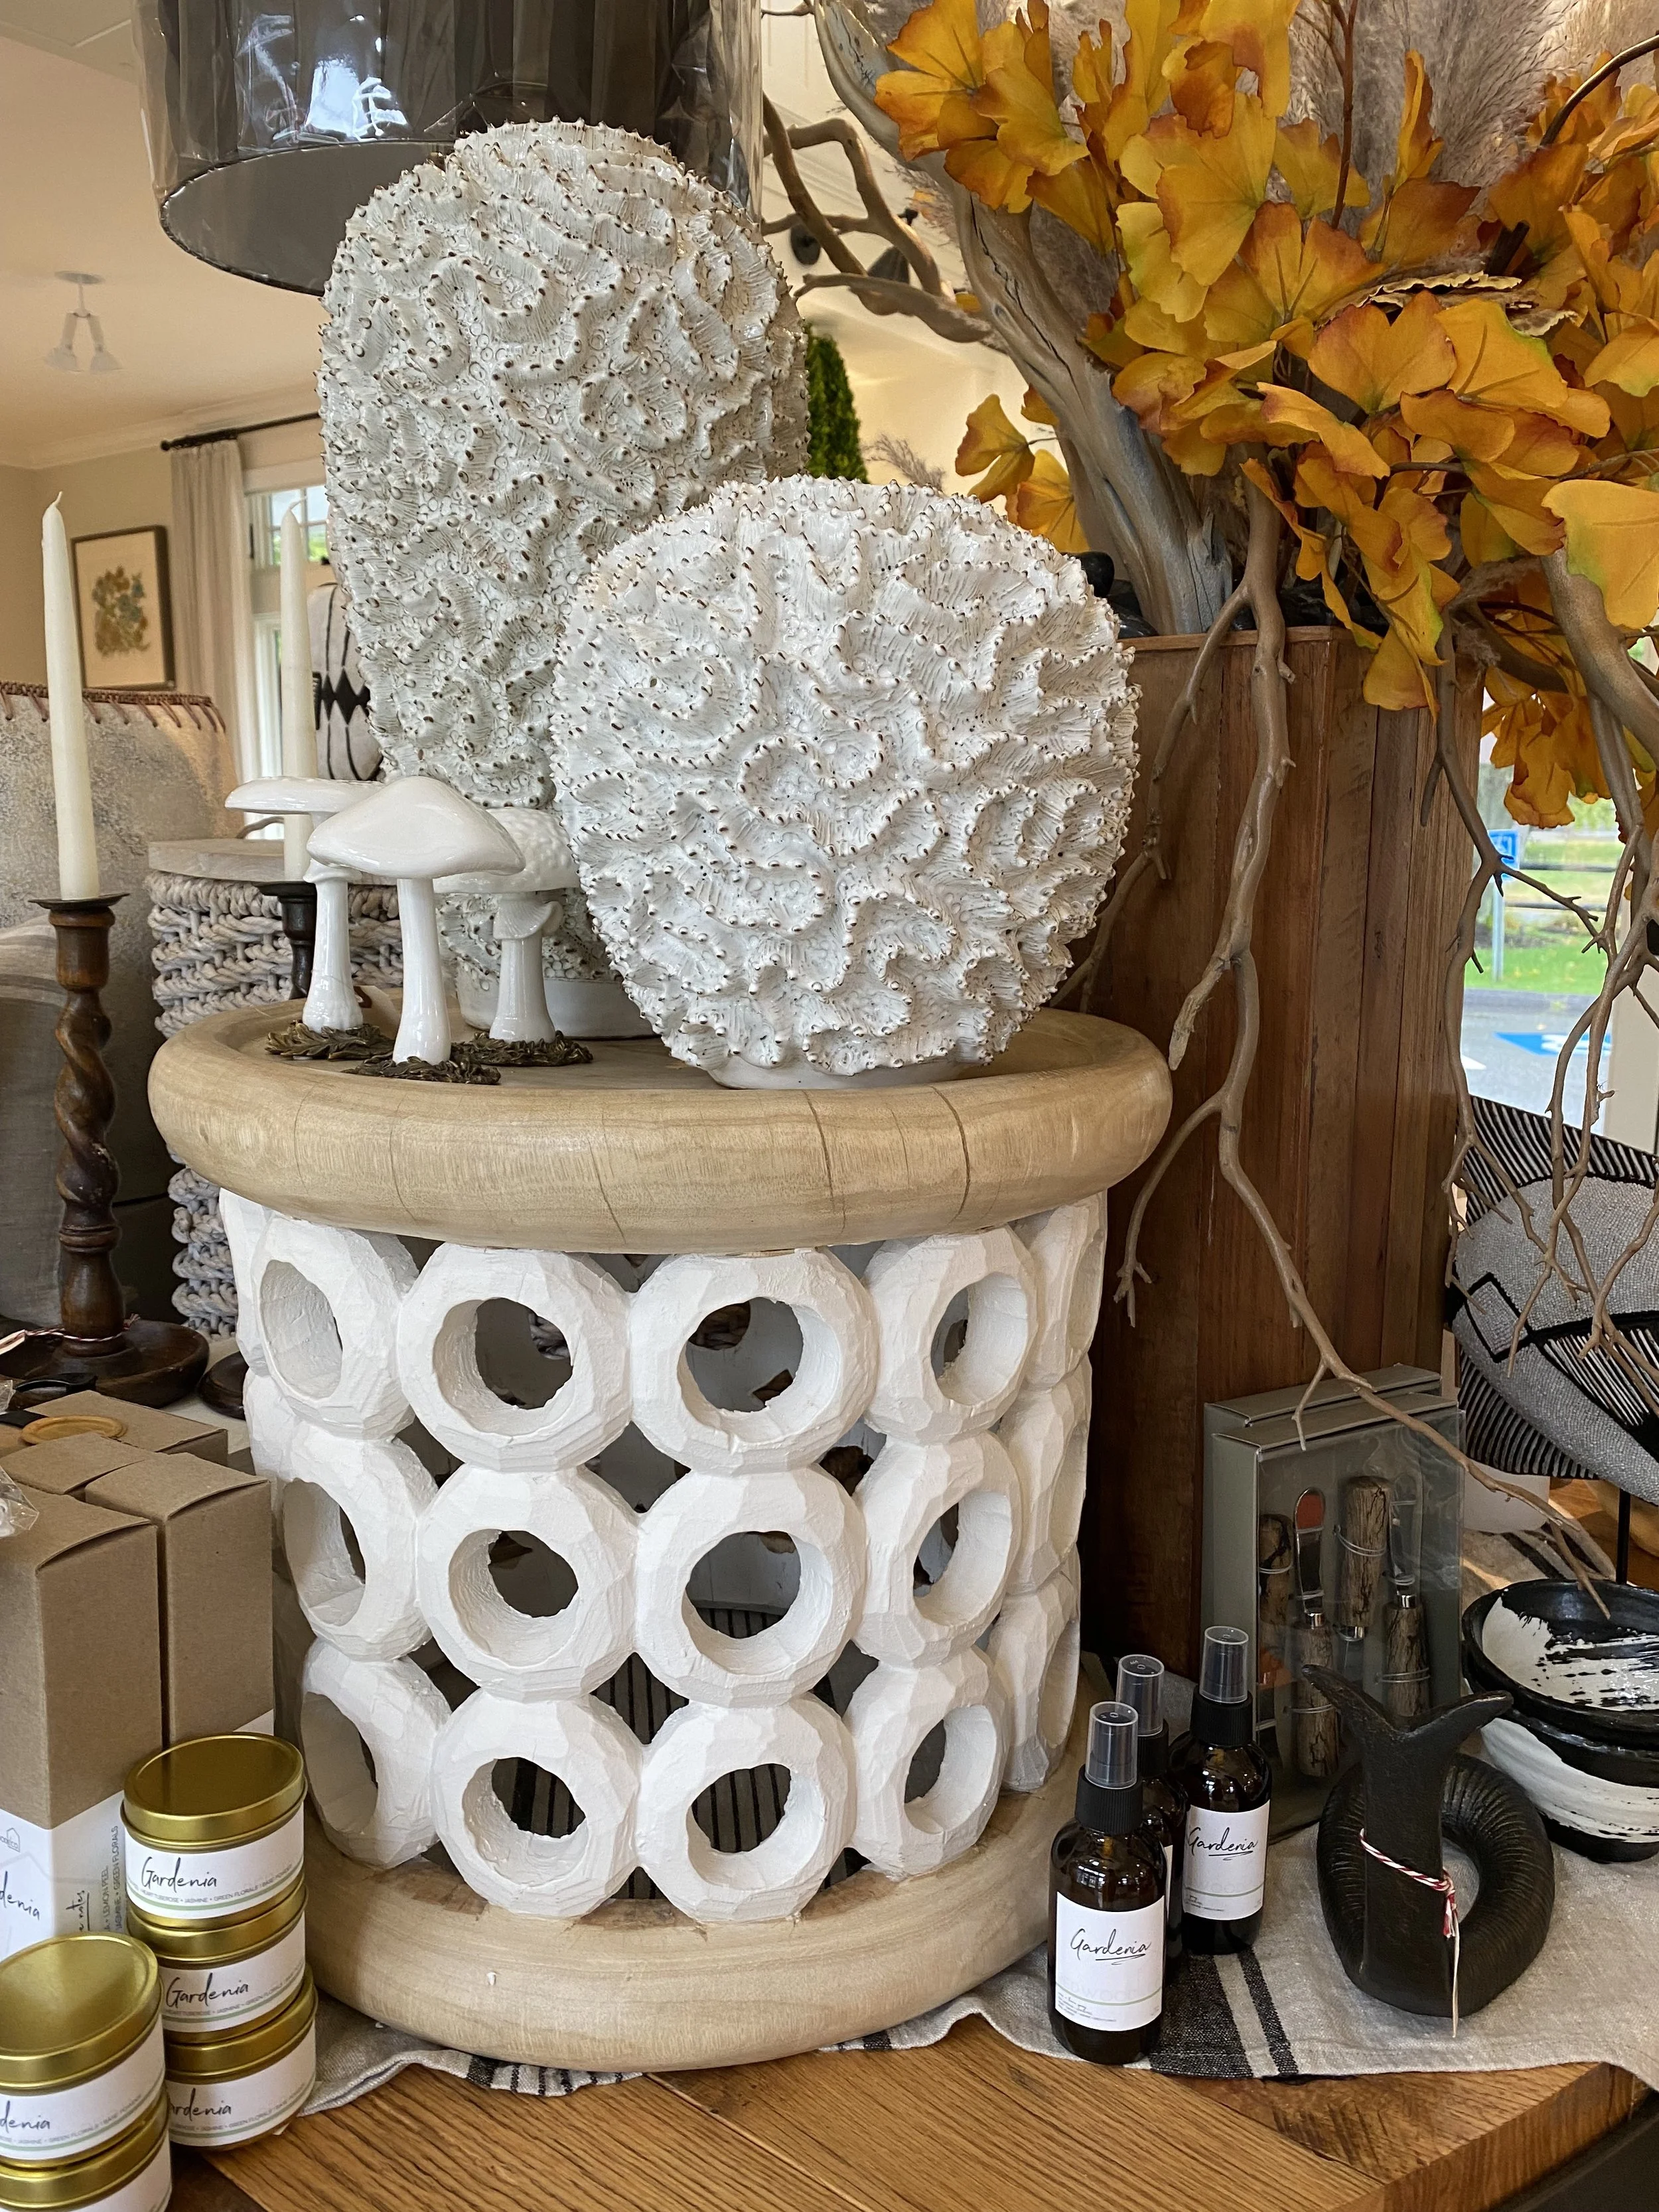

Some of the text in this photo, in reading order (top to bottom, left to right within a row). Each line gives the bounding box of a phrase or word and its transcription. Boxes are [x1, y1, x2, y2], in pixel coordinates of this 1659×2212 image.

[1187, 1826, 1258, 1856] Gardenia
[141, 1856, 217, 1893] Gardenia
[0, 1871, 40, 1921] denia
[1070, 1928, 1152, 1961] Gardenia
[166, 1972, 249, 2010] Gardenia
[0, 2100, 50, 2134] denia
[169, 2088, 231, 2122] ardenia
